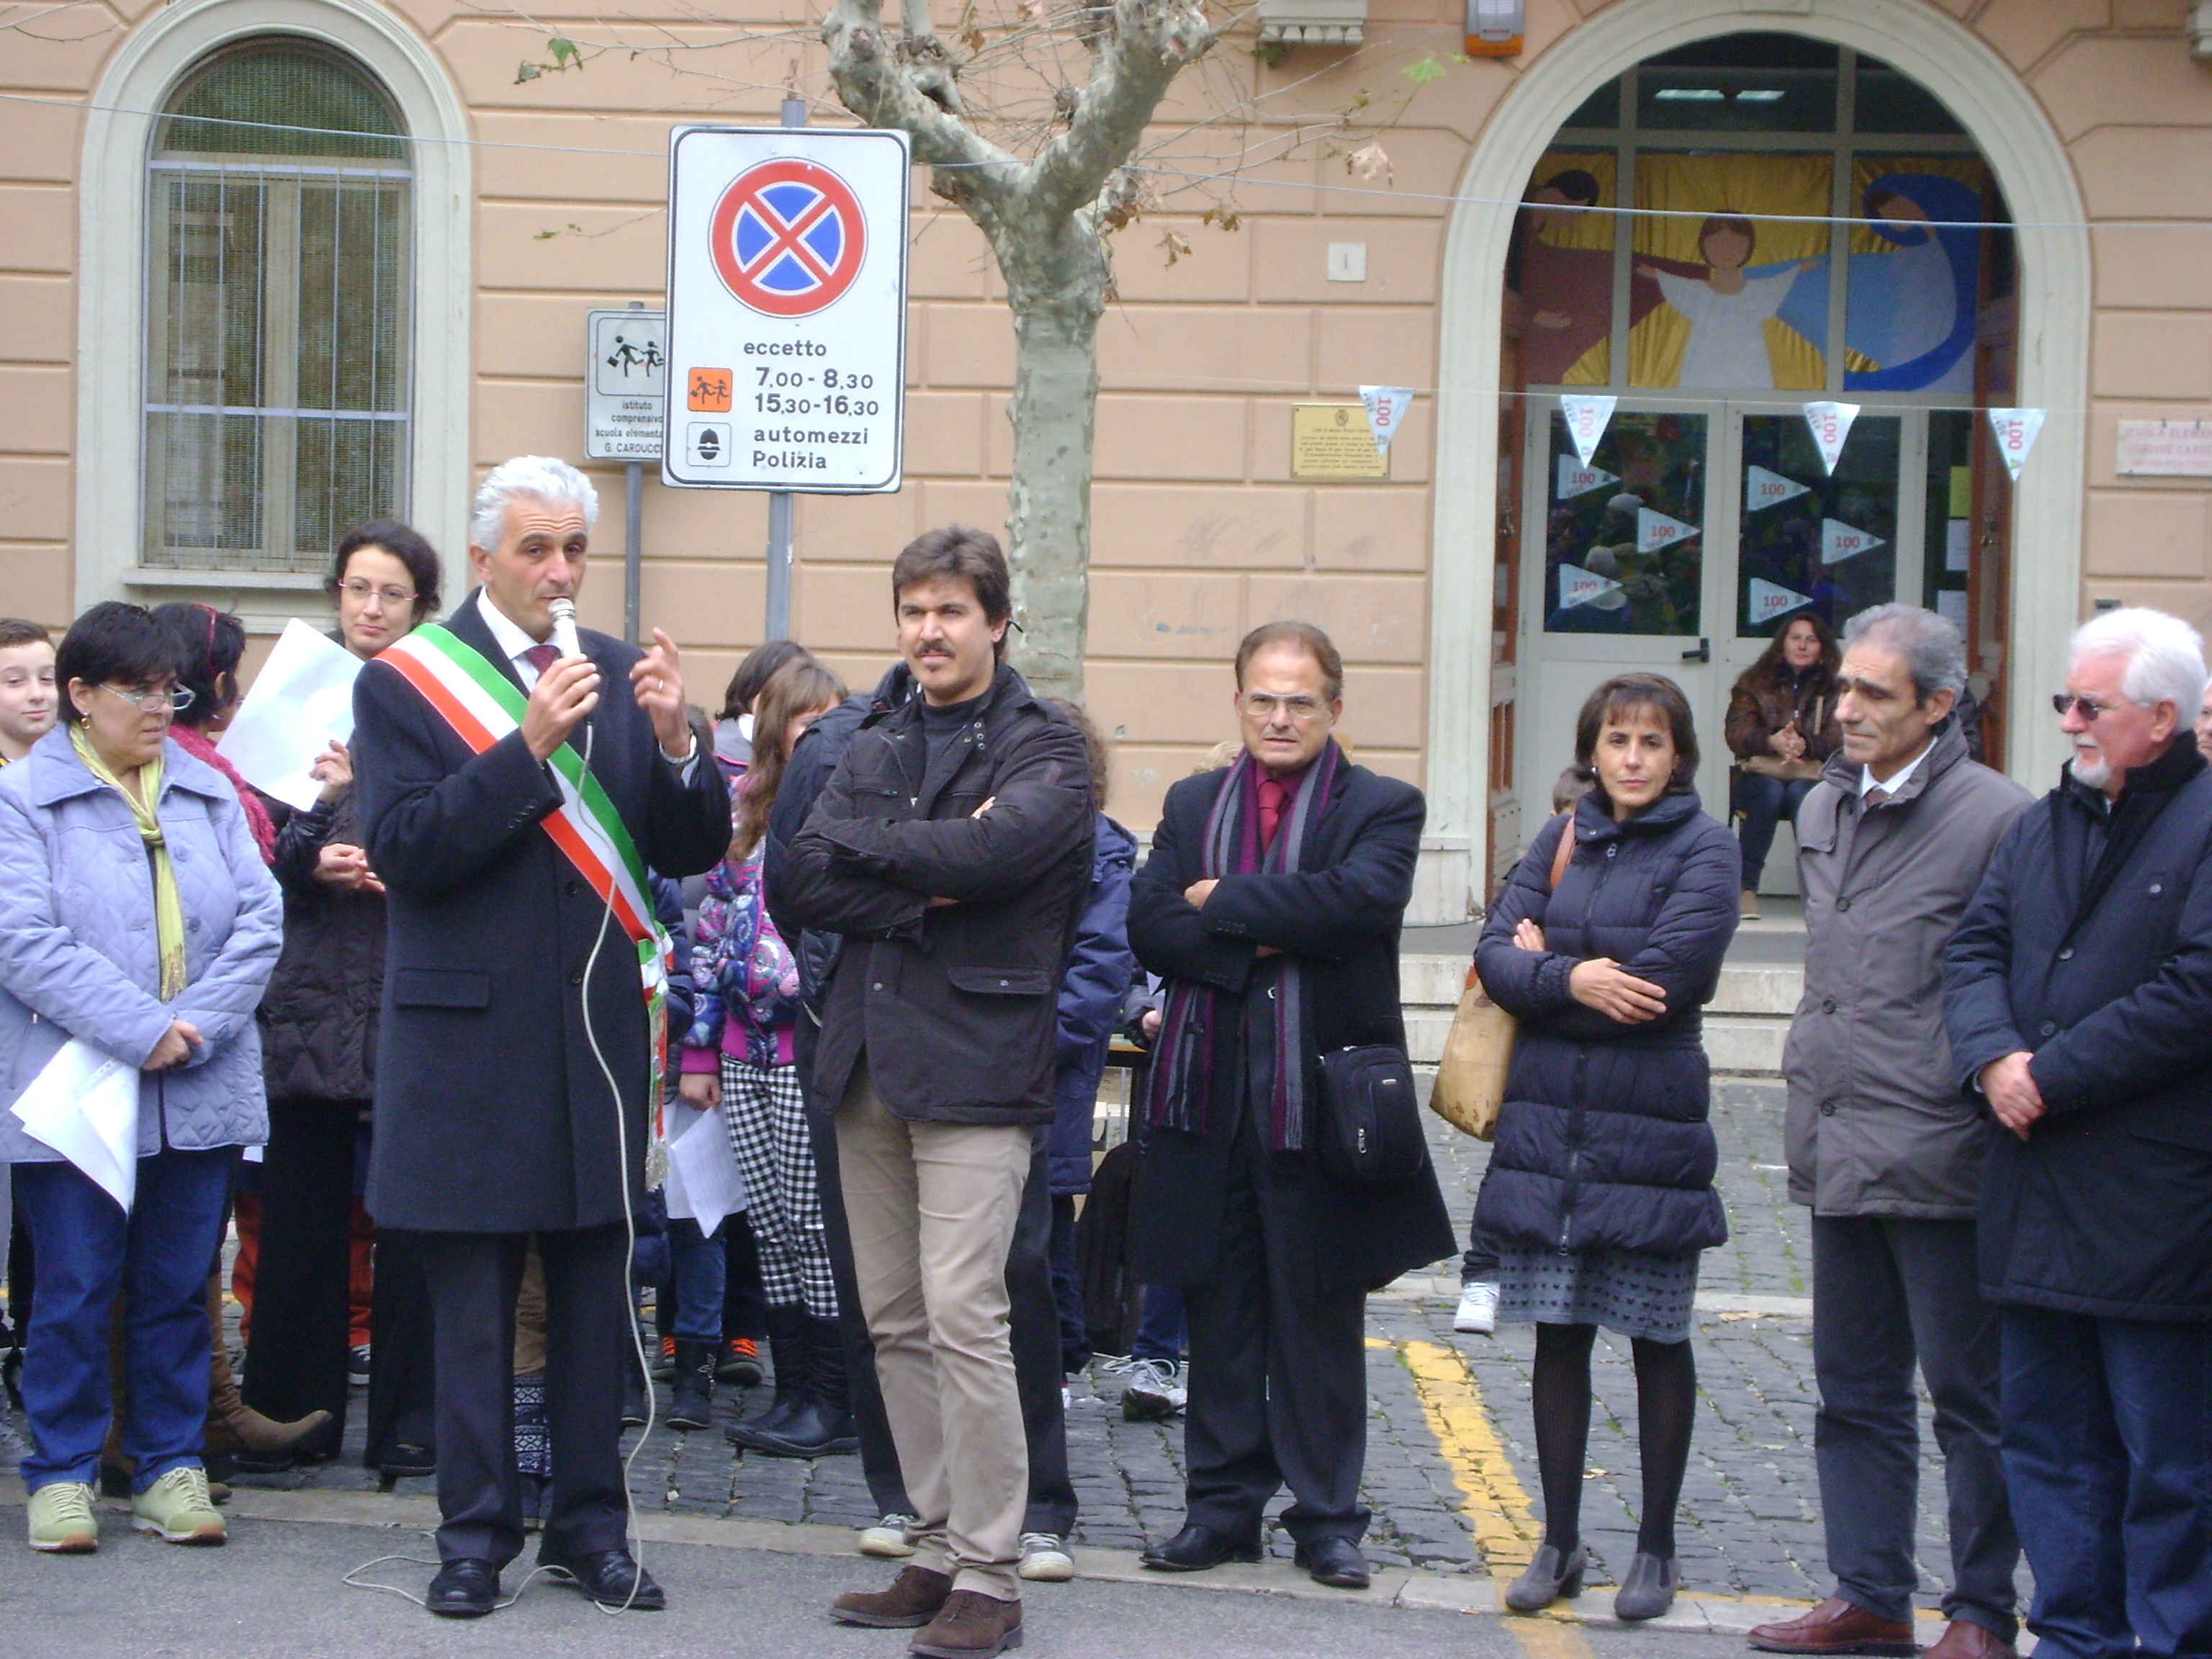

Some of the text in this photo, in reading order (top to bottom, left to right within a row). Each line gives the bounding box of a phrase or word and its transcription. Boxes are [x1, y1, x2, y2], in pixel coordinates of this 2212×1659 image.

[744, 340, 827, 356] eccetto
[622, 400, 652, 410] istituto
[1376, 397, 1392, 426] 100
[1579, 408, 1594, 436] 100
[595, 428, 622, 437] scuola
[1824, 414, 1837, 443] 100
[2008, 420, 2023, 449] 100
[754, 426, 868, 444] automezzi
[752, 450, 827, 469] Polizia
[1571, 472, 1596, 483] 100
[1761, 484, 1786, 495] 100
[1651, 526, 1676, 537] 100
[1836, 536, 1860, 547] 100
[1573, 580, 1597, 592] 100
[1764, 595, 1788, 607] 100
